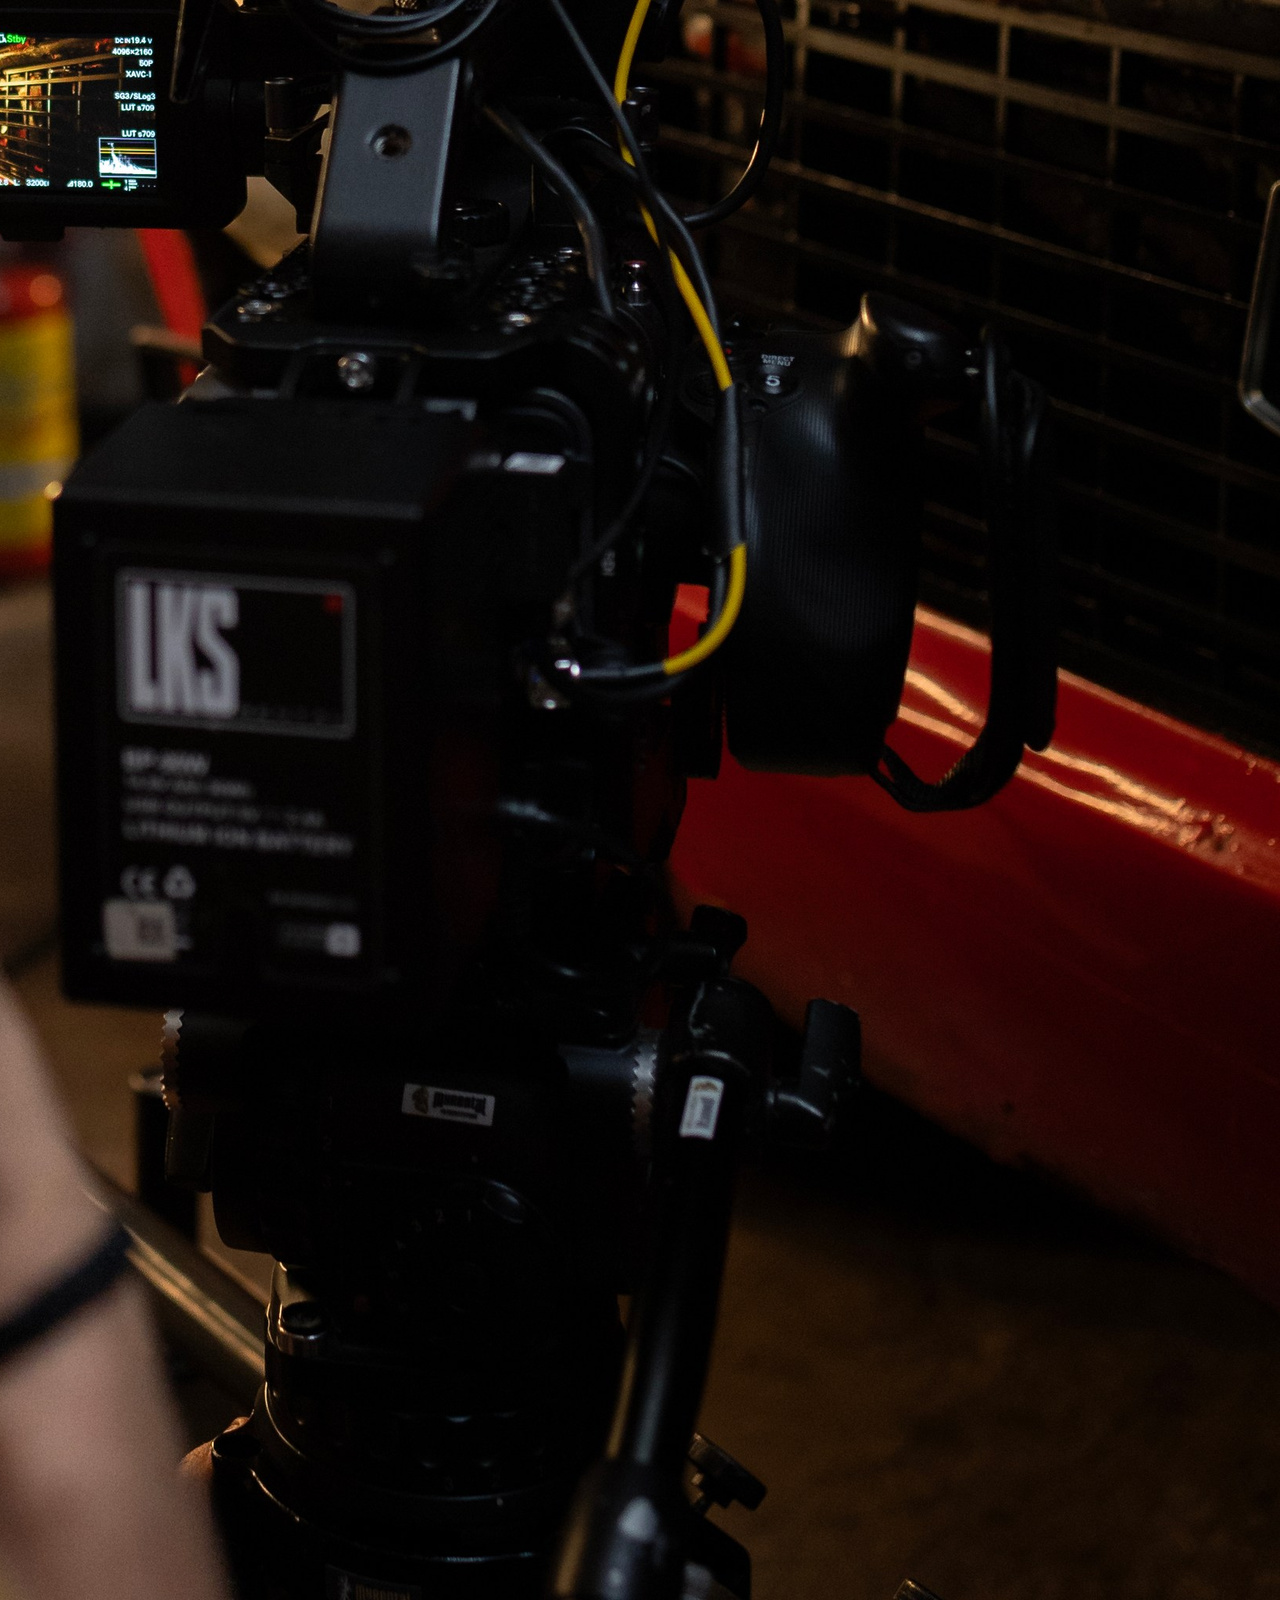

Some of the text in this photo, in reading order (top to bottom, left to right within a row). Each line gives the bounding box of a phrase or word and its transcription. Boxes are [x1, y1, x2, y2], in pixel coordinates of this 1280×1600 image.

[7, 34, 27, 45] Stby
[125, 70, 152, 78] XAVC-I
[114, 92, 156, 101] SG3/SLog3
[761, 353, 795, 361] DIRECT
[765, 375, 781, 387] 5
[127, 581, 242, 720] LKS
